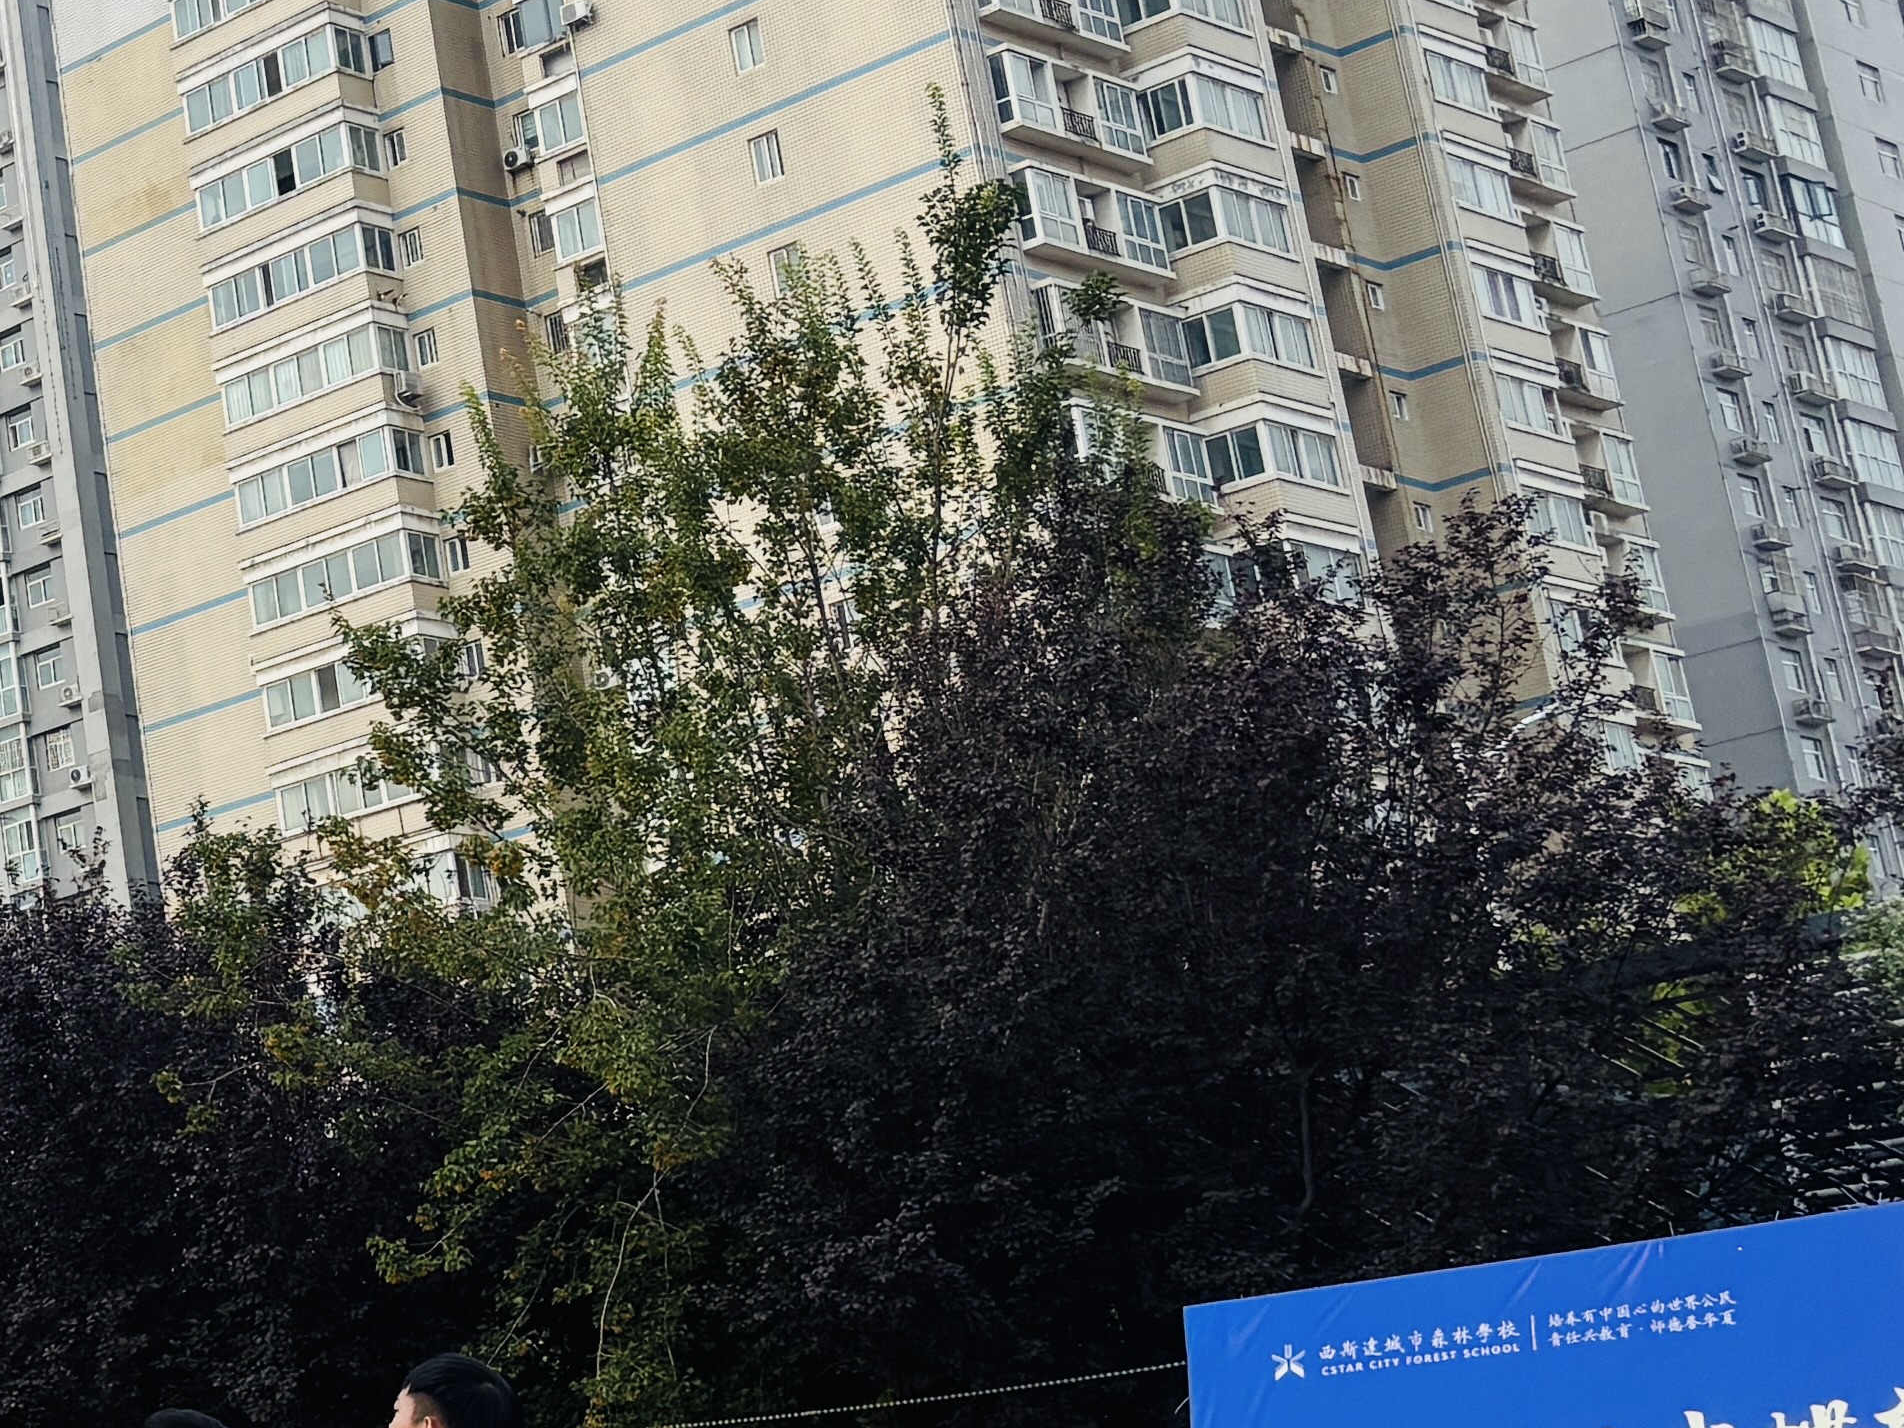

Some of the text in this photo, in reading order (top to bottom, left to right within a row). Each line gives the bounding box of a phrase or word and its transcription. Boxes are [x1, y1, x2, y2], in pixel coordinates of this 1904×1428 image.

[1321, 1343, 1521, 1376] CSTAR CITY FOREST SCHOOL
